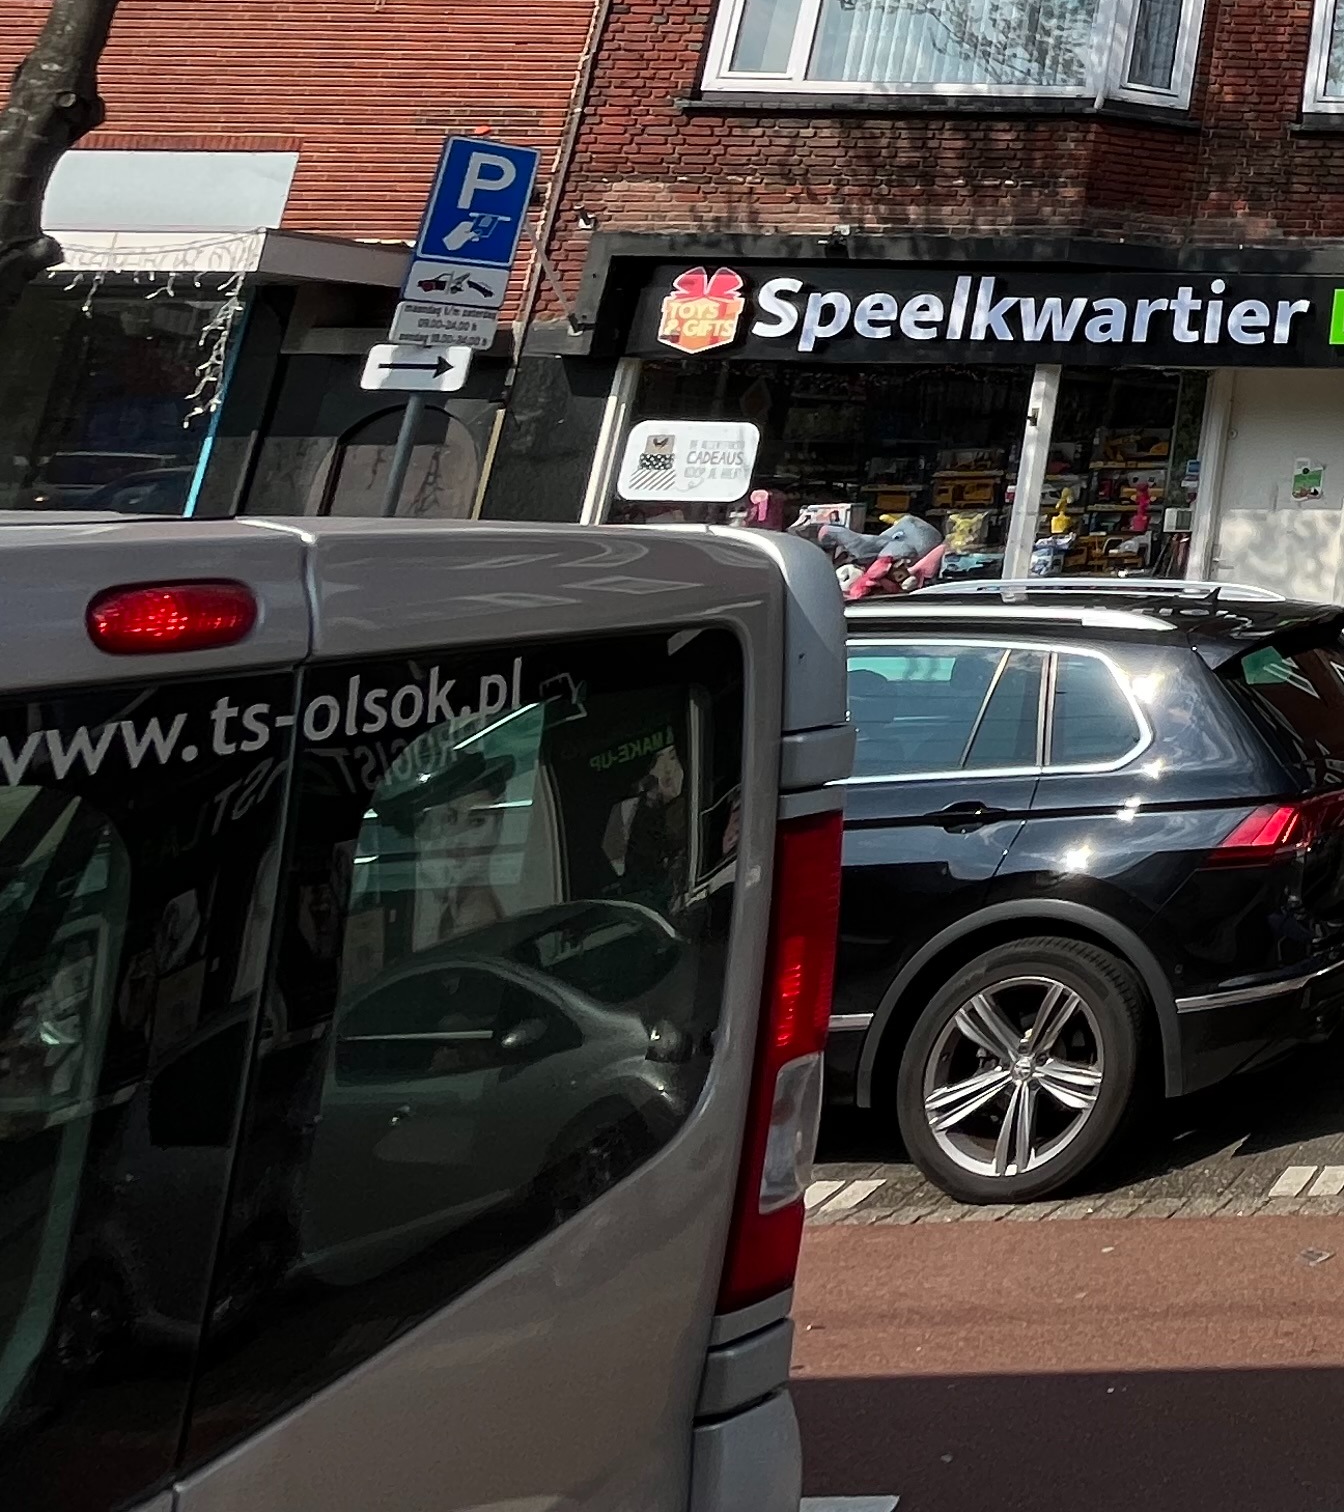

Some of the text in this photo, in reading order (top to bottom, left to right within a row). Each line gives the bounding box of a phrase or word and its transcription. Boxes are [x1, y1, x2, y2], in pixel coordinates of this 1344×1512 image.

[457, 151, 516, 210] P
[670, 302, 720, 319] TOYS
[751, 276, 1309, 352] Speelkwartier
[664, 319, 734, 337] & GIFTS
[686, 451, 745, 465] CADEAUS
